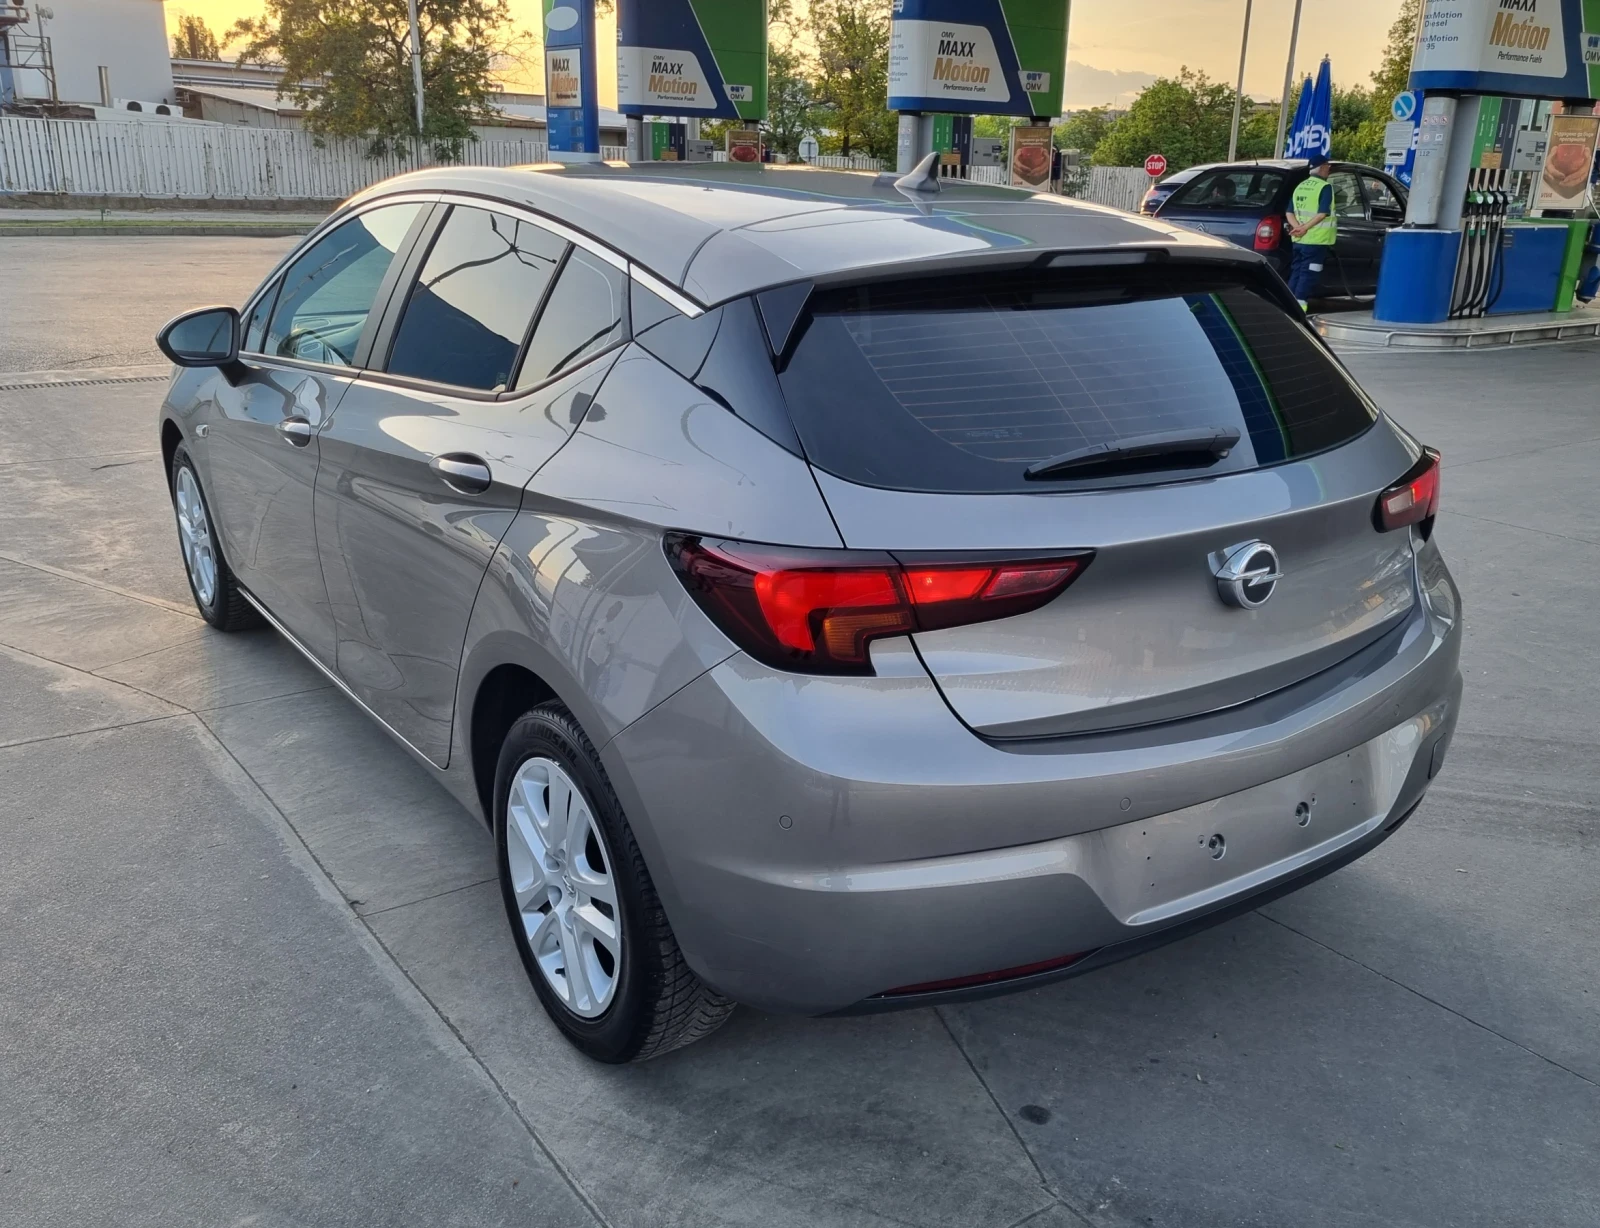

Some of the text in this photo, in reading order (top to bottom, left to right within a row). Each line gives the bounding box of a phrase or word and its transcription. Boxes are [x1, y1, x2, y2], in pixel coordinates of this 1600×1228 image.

[1425, 19, 1448, 28] Diesel
[941, 31, 955, 39] OMV
[1488, 12, 1550, 51] Motion
[937, 39, 976, 58] MAXX
[1426, 42, 1436, 50] 95
[1497, 51, 1543, 64] Performance Fuels
[552, 58, 570, 71] MAXX
[651, 61, 684, 75] MAXX
[932, 57, 990, 84] Motion
[551, 73, 578, 92] Motion
[648, 74, 698, 95] Motion
[943, 83, 986, 93] Performance Fuels
[1025, 82, 1042, 91] OMV
[1147, 162, 1164, 170] STOP
